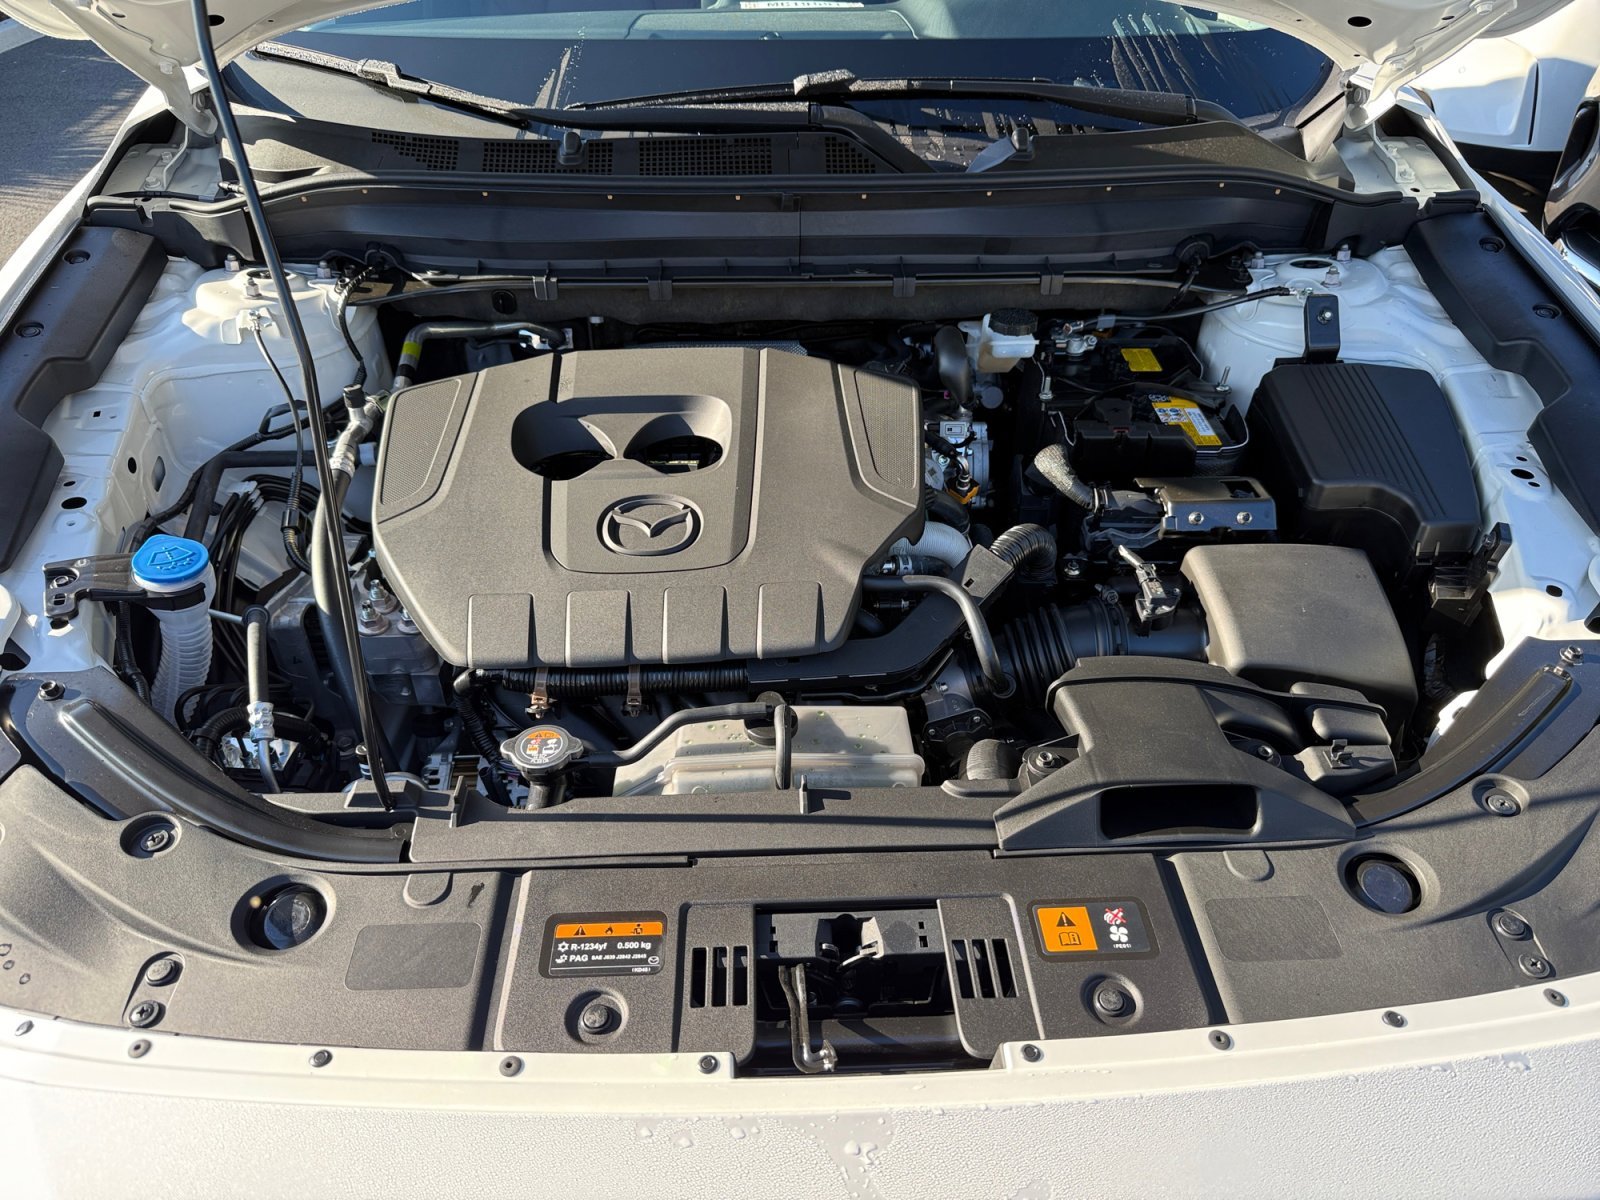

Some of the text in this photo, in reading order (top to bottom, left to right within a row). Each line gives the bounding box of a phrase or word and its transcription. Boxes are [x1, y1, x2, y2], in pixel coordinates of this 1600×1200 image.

[570, 941, 652, 951] R-1234yf 0.500 kg
